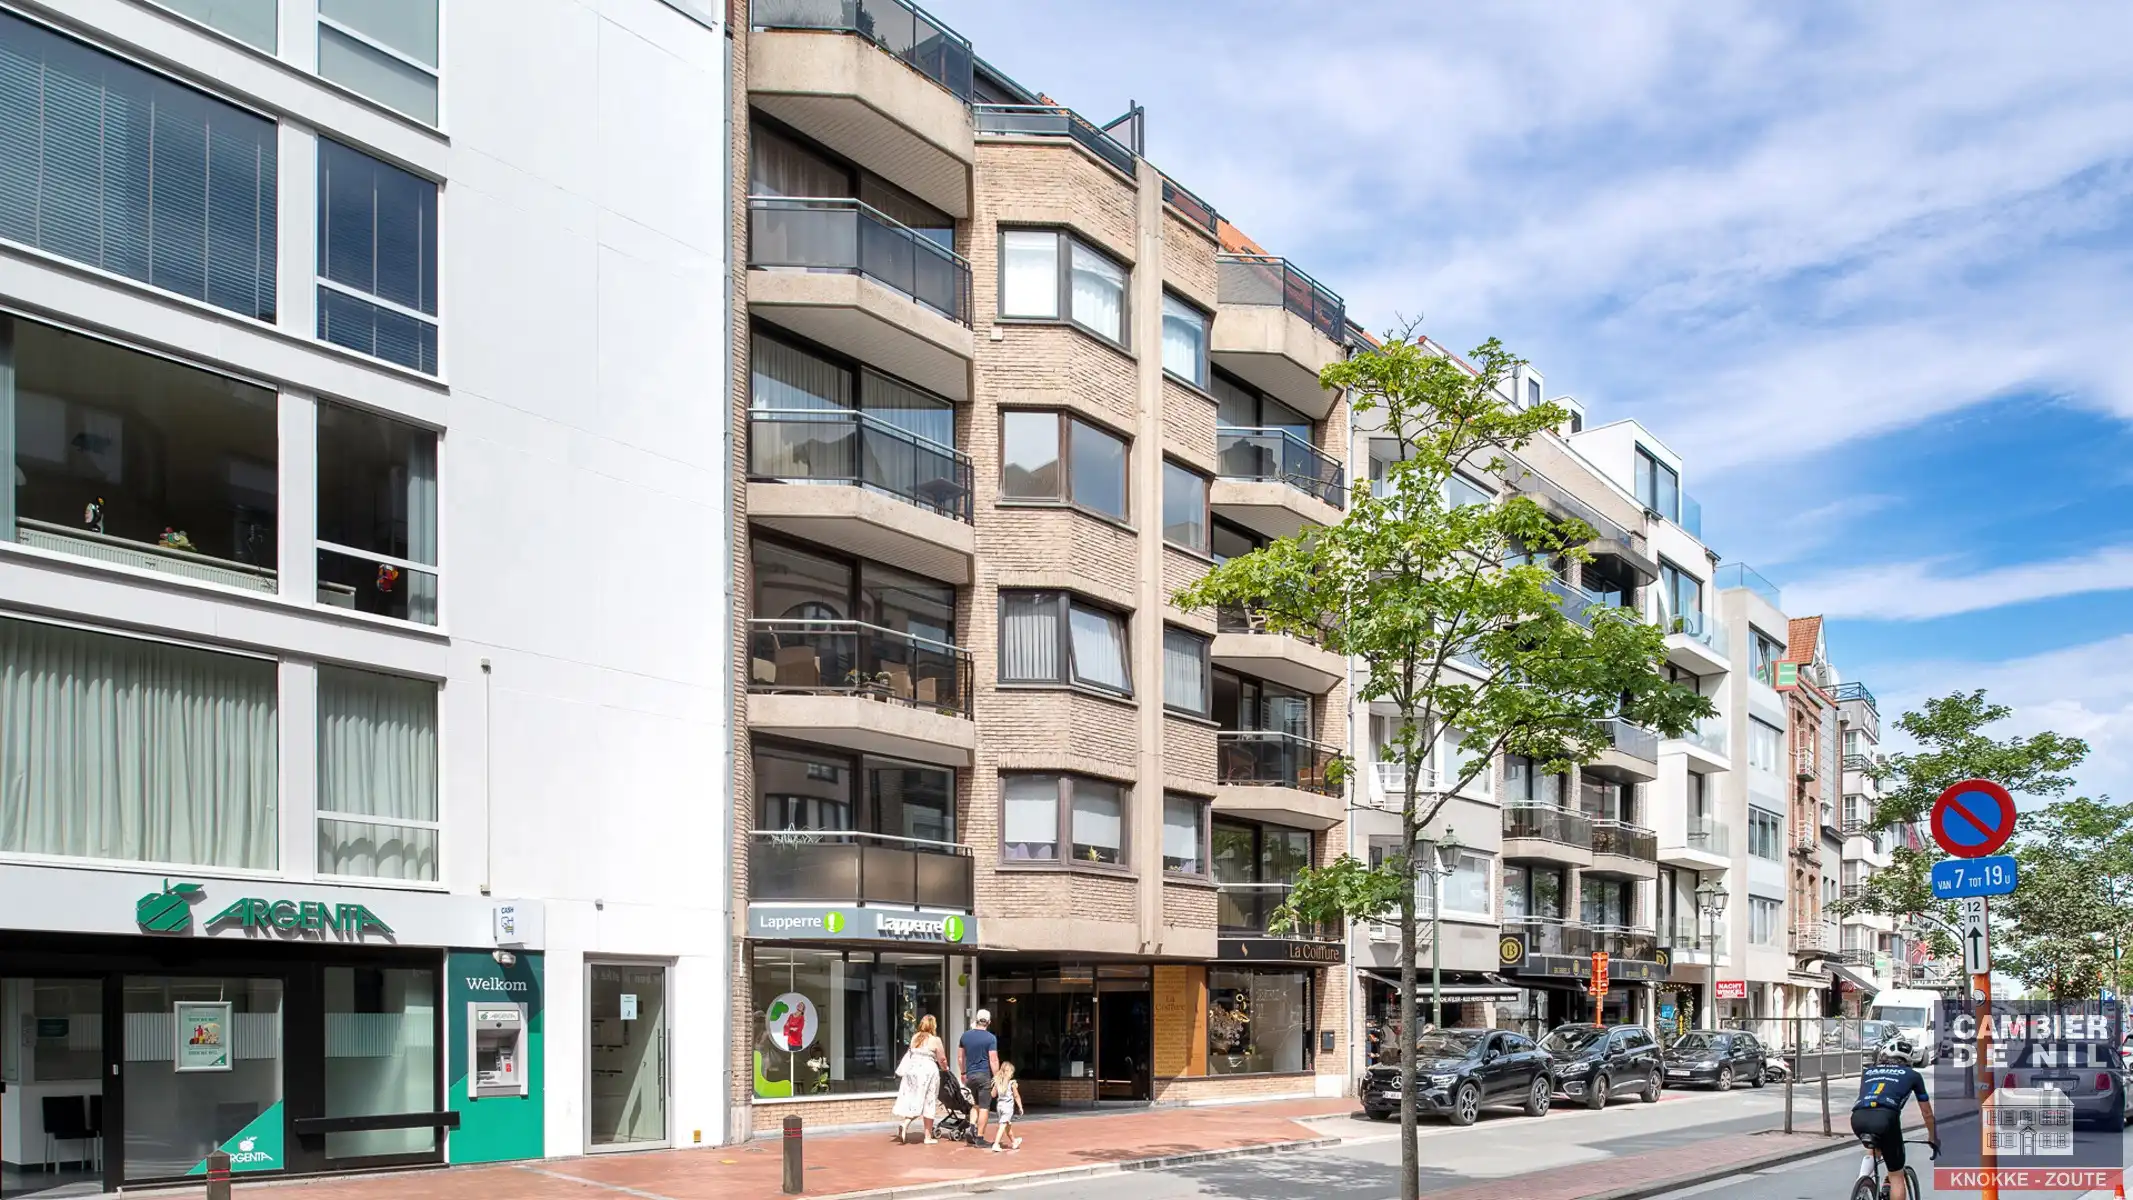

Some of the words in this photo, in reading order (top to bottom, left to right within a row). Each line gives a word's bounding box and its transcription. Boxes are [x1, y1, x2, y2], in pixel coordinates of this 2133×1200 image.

[1937, 880, 1952, 890] VAN
[1954, 868, 1965, 889] 7
[1968, 877, 1982, 888] TOT
[1984, 865, 2003, 886] 19
[2004, 874, 2011, 885] U
[501, 906, 514, 914] CASH
[1967, 901, 1981, 912] 12
[203, 897, 396, 934] ARGENTA
[760, 915, 822, 930] Lapperre
[1969, 914, 1980, 923] m
[876, 913, 944, 934] Lapperre
[1289, 942, 1301, 958] La
[1302, 943, 1340, 961] Coiffure
[465, 976, 528, 991] Welkom
[229, 1152, 274, 1164] RGENTA
